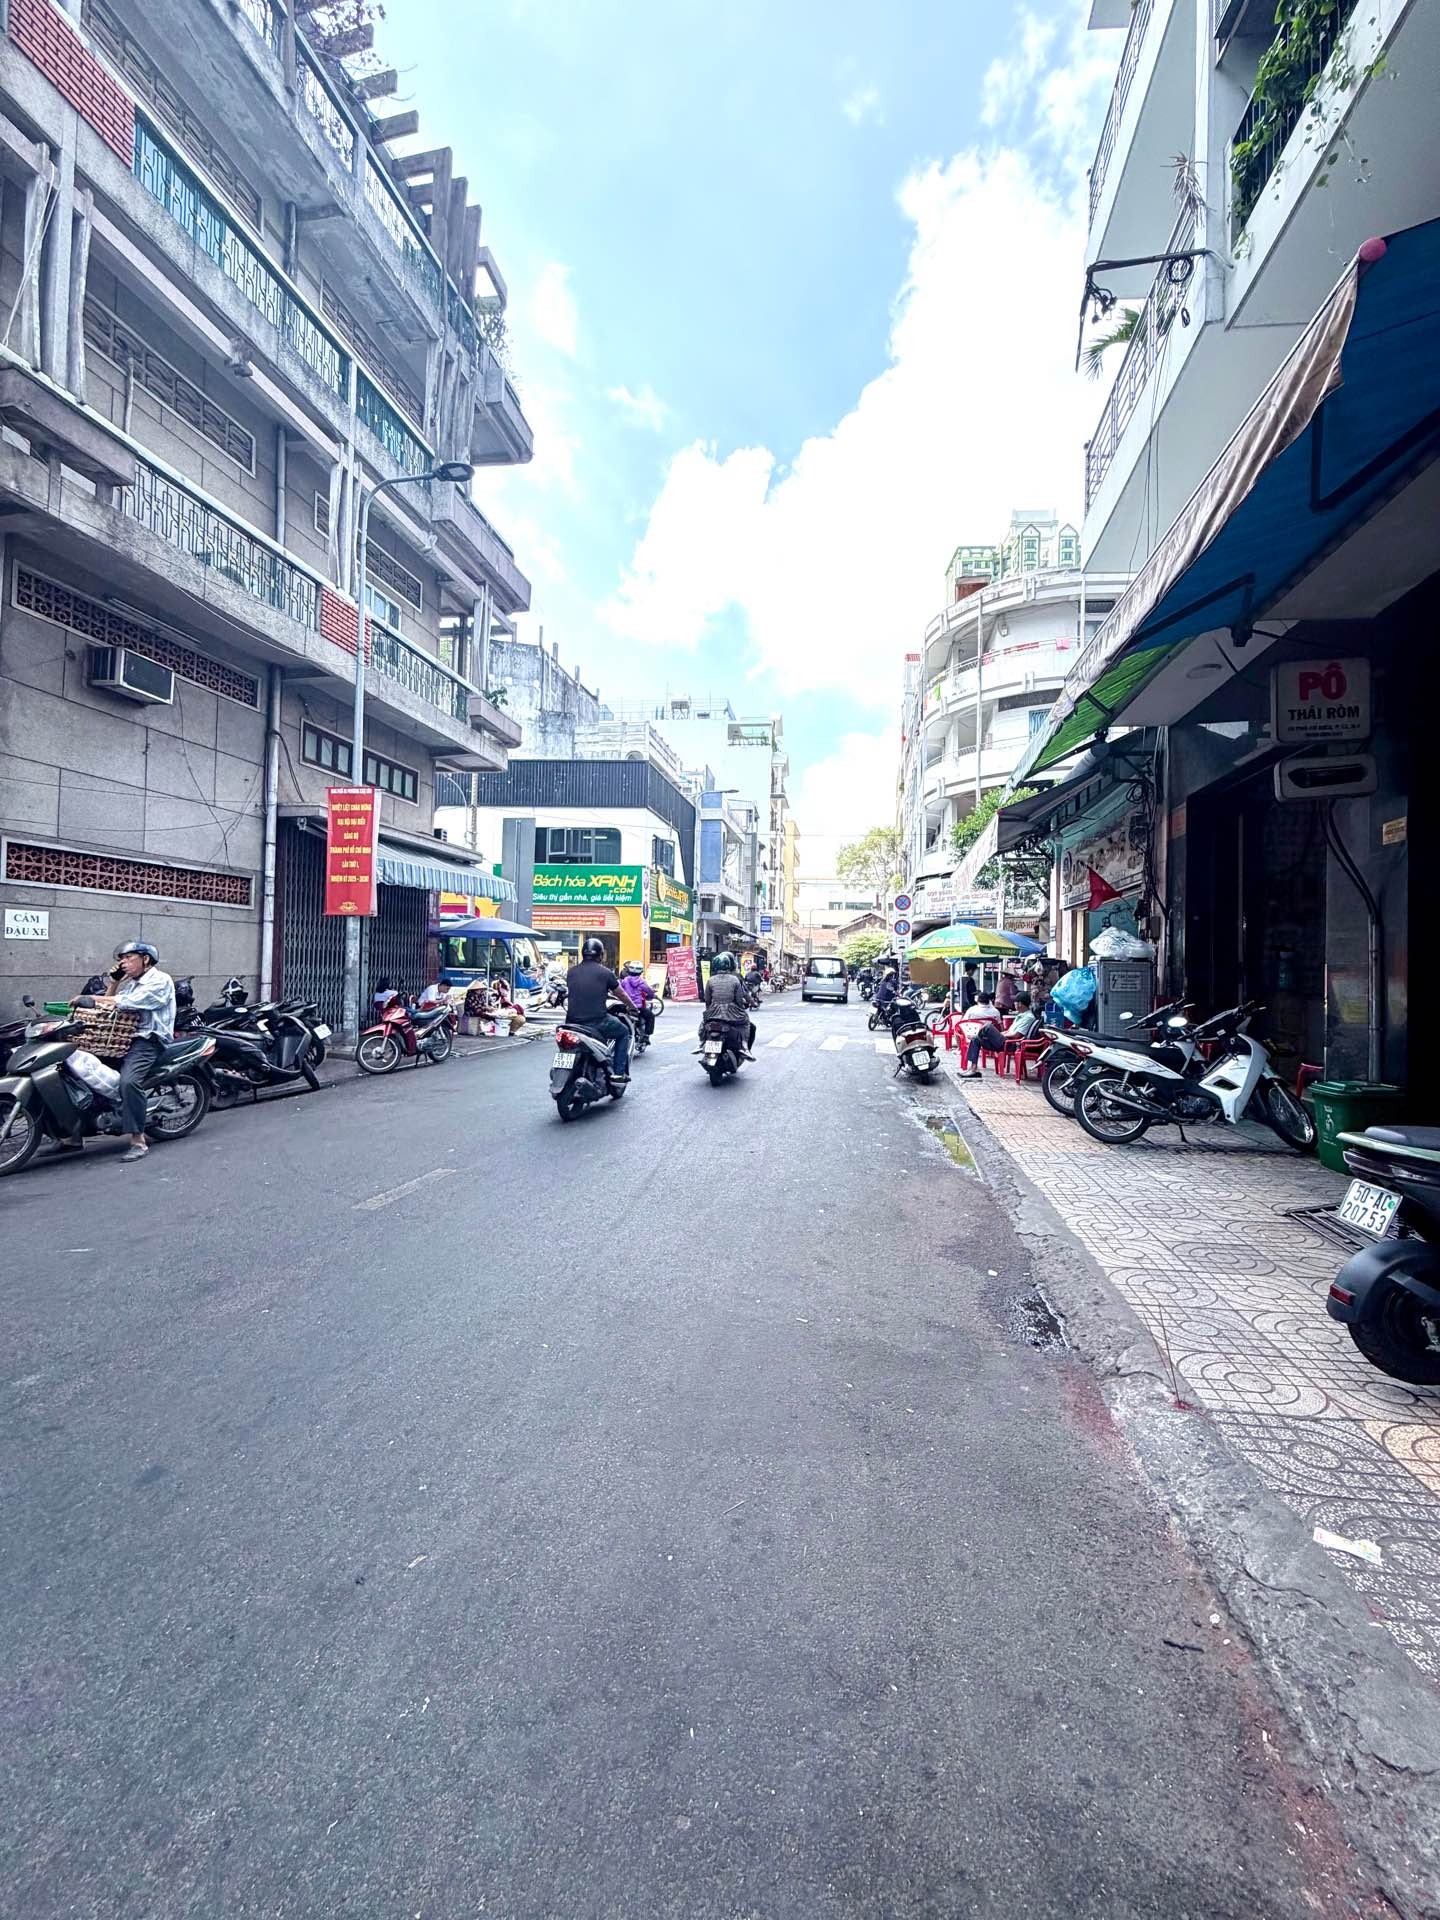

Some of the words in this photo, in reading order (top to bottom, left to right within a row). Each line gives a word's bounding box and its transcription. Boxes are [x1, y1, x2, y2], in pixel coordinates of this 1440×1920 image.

[1299, 662, 1346, 701] PÔ
[1288, 705, 1322, 720] THÁI
[533, 874, 562, 887] Bách
[564, 875, 586, 888] hóa
[587, 875, 637, 887] XANH
[32, 928, 48, 937] XE
[1354, 1184, 1392, 1211] 50-AC
[1342, 1201, 1386, 1231] 207.53
